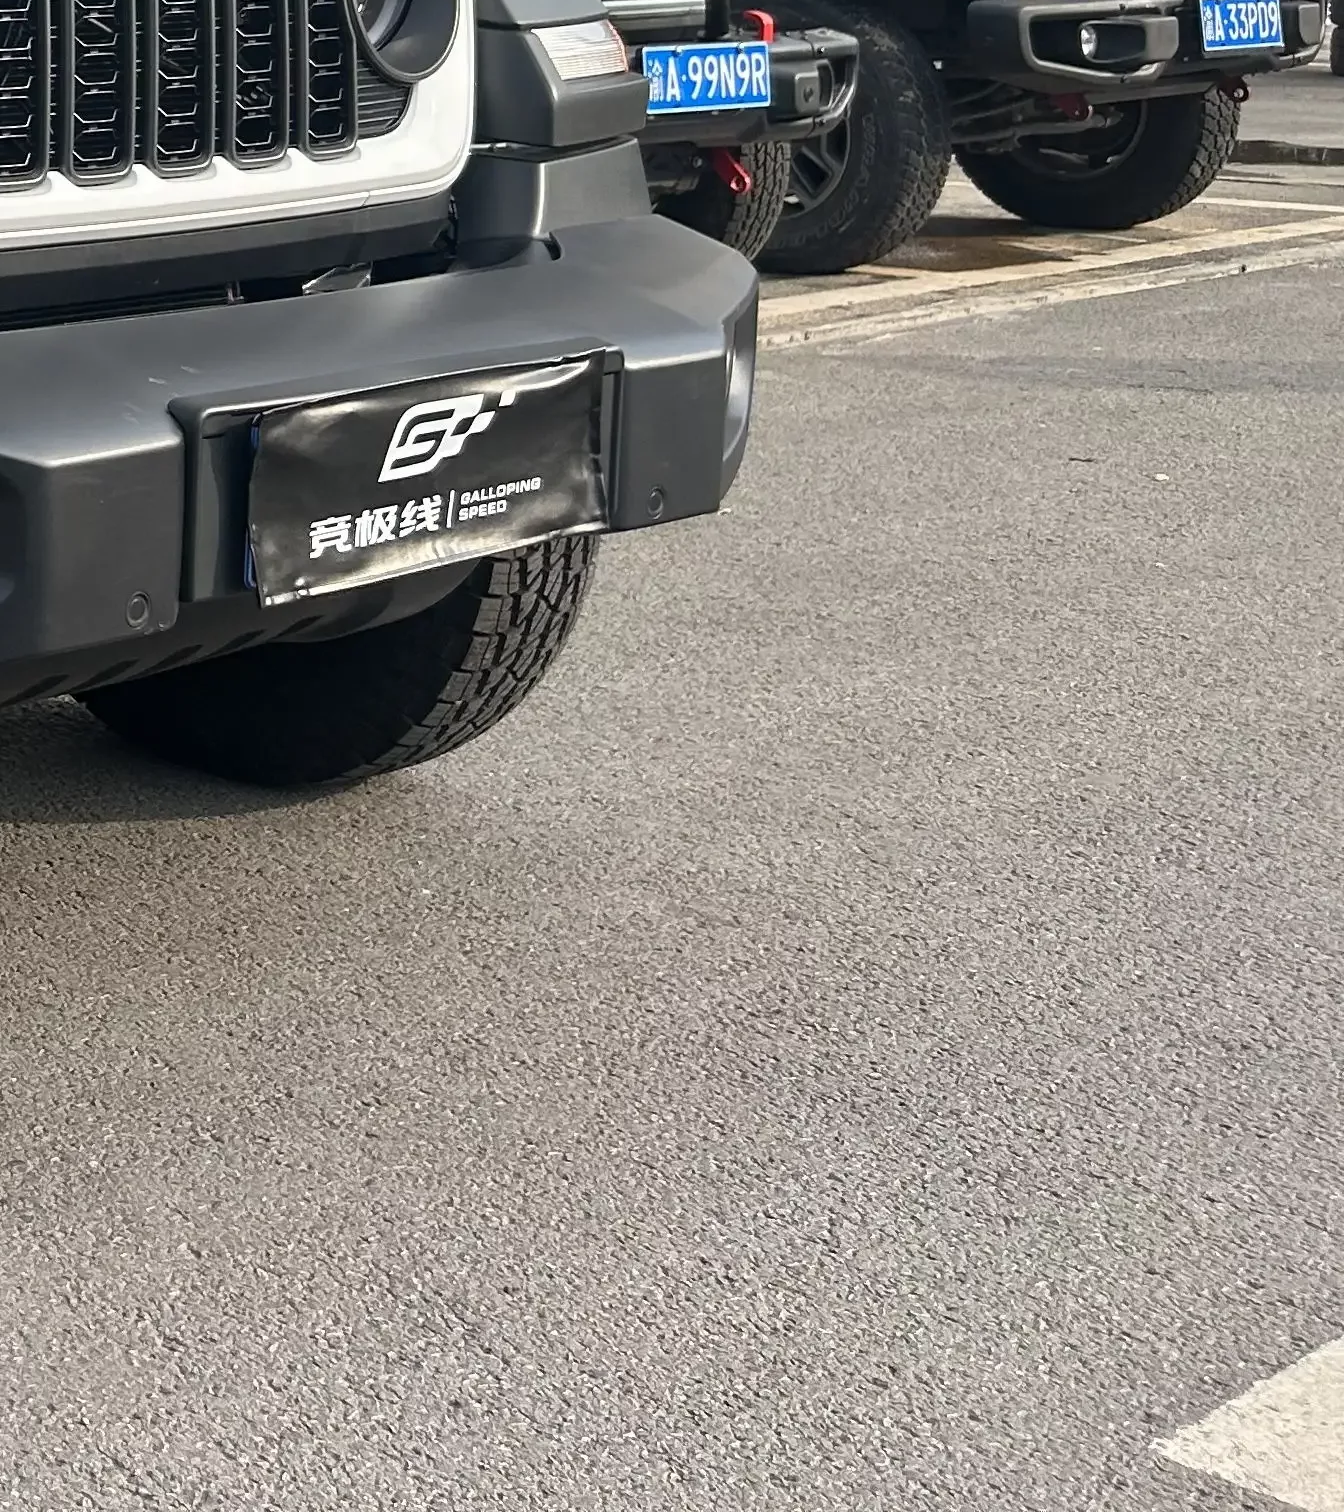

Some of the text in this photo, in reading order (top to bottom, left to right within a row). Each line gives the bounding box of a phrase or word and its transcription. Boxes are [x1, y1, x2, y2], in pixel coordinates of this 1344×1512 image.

[459, 476, 542, 506] GALLOPING
[458, 499, 508, 522] SPEED
[308, 494, 443, 560] 竞极线
